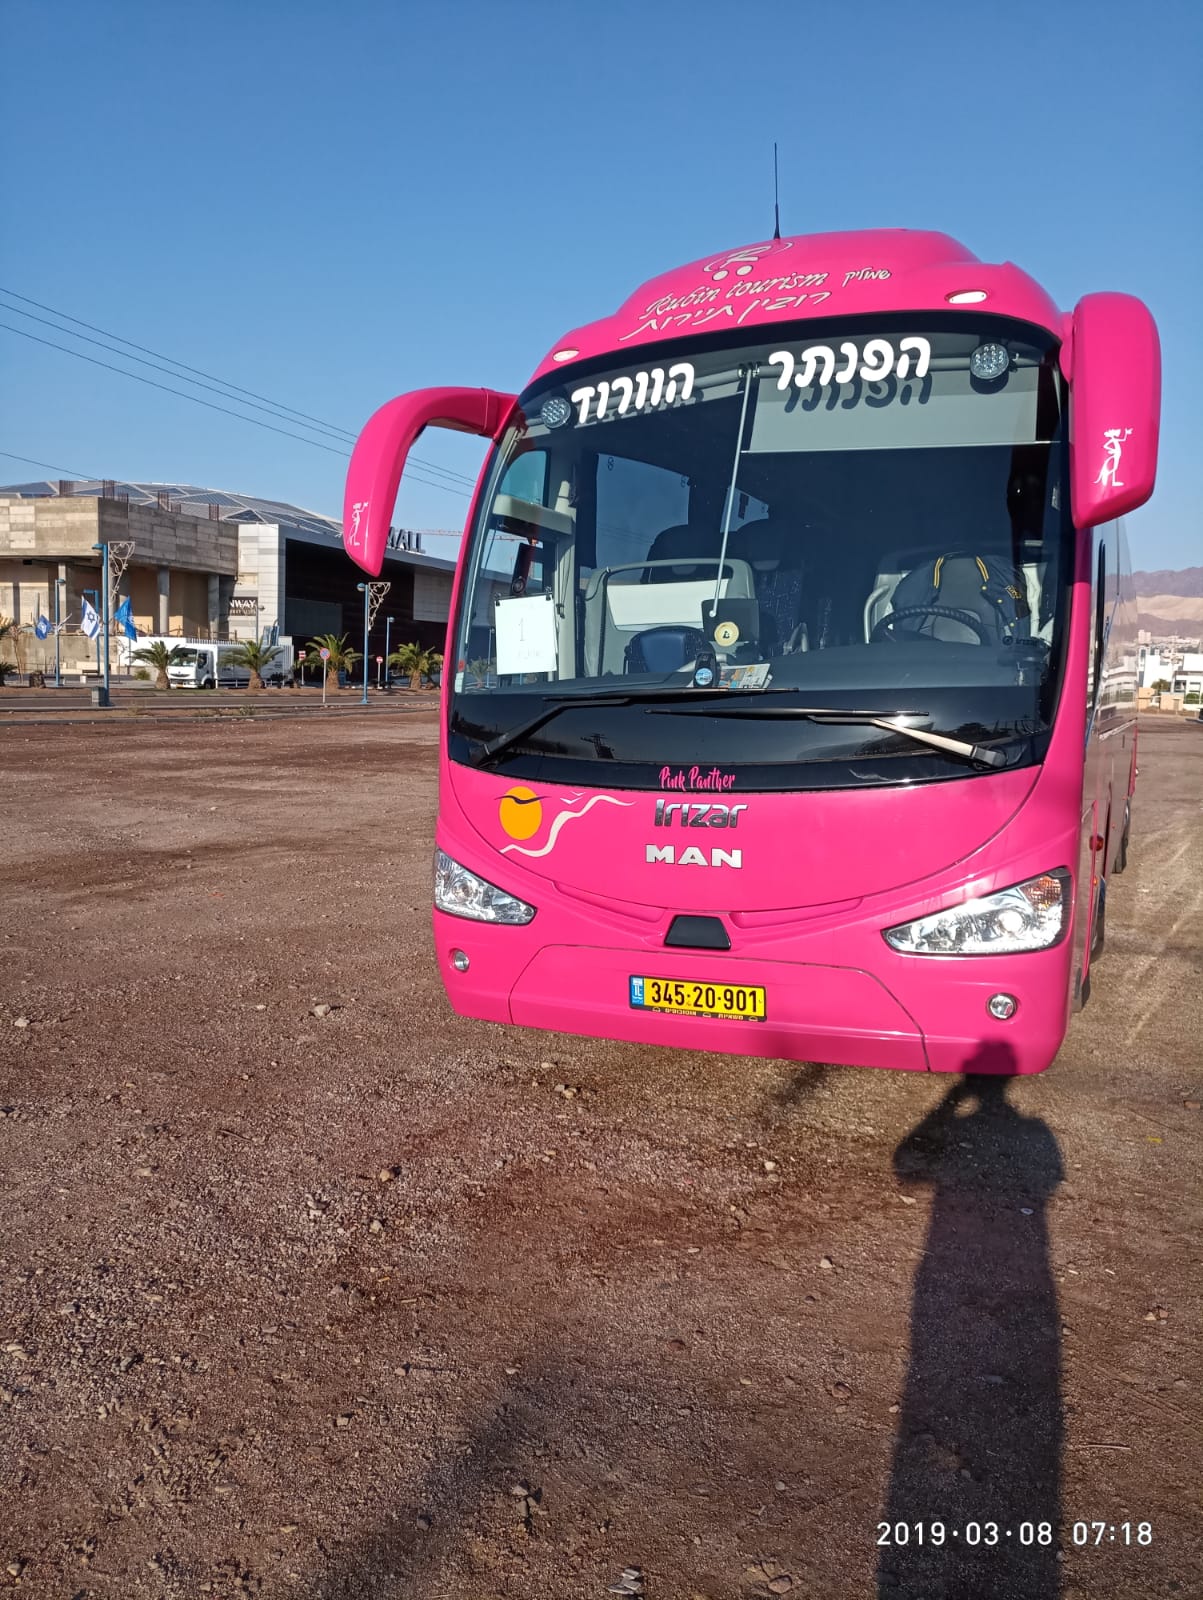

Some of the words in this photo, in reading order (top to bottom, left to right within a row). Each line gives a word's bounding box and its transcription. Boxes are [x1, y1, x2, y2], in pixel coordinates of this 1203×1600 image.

[840, 266, 891, 288] שמוליק
[638, 285, 720, 321] Rubin
[724, 271, 829, 299] tourism
[736, 291, 832, 325] רובין
[768, 336, 932, 391] הפנתר
[570, 362, 695, 424] הוורוד
[658, 765, 687, 792] Pink
[688, 765, 736, 793] Panther
[654, 798, 748, 828] Irizar
[645, 844, 743, 869] MAN
